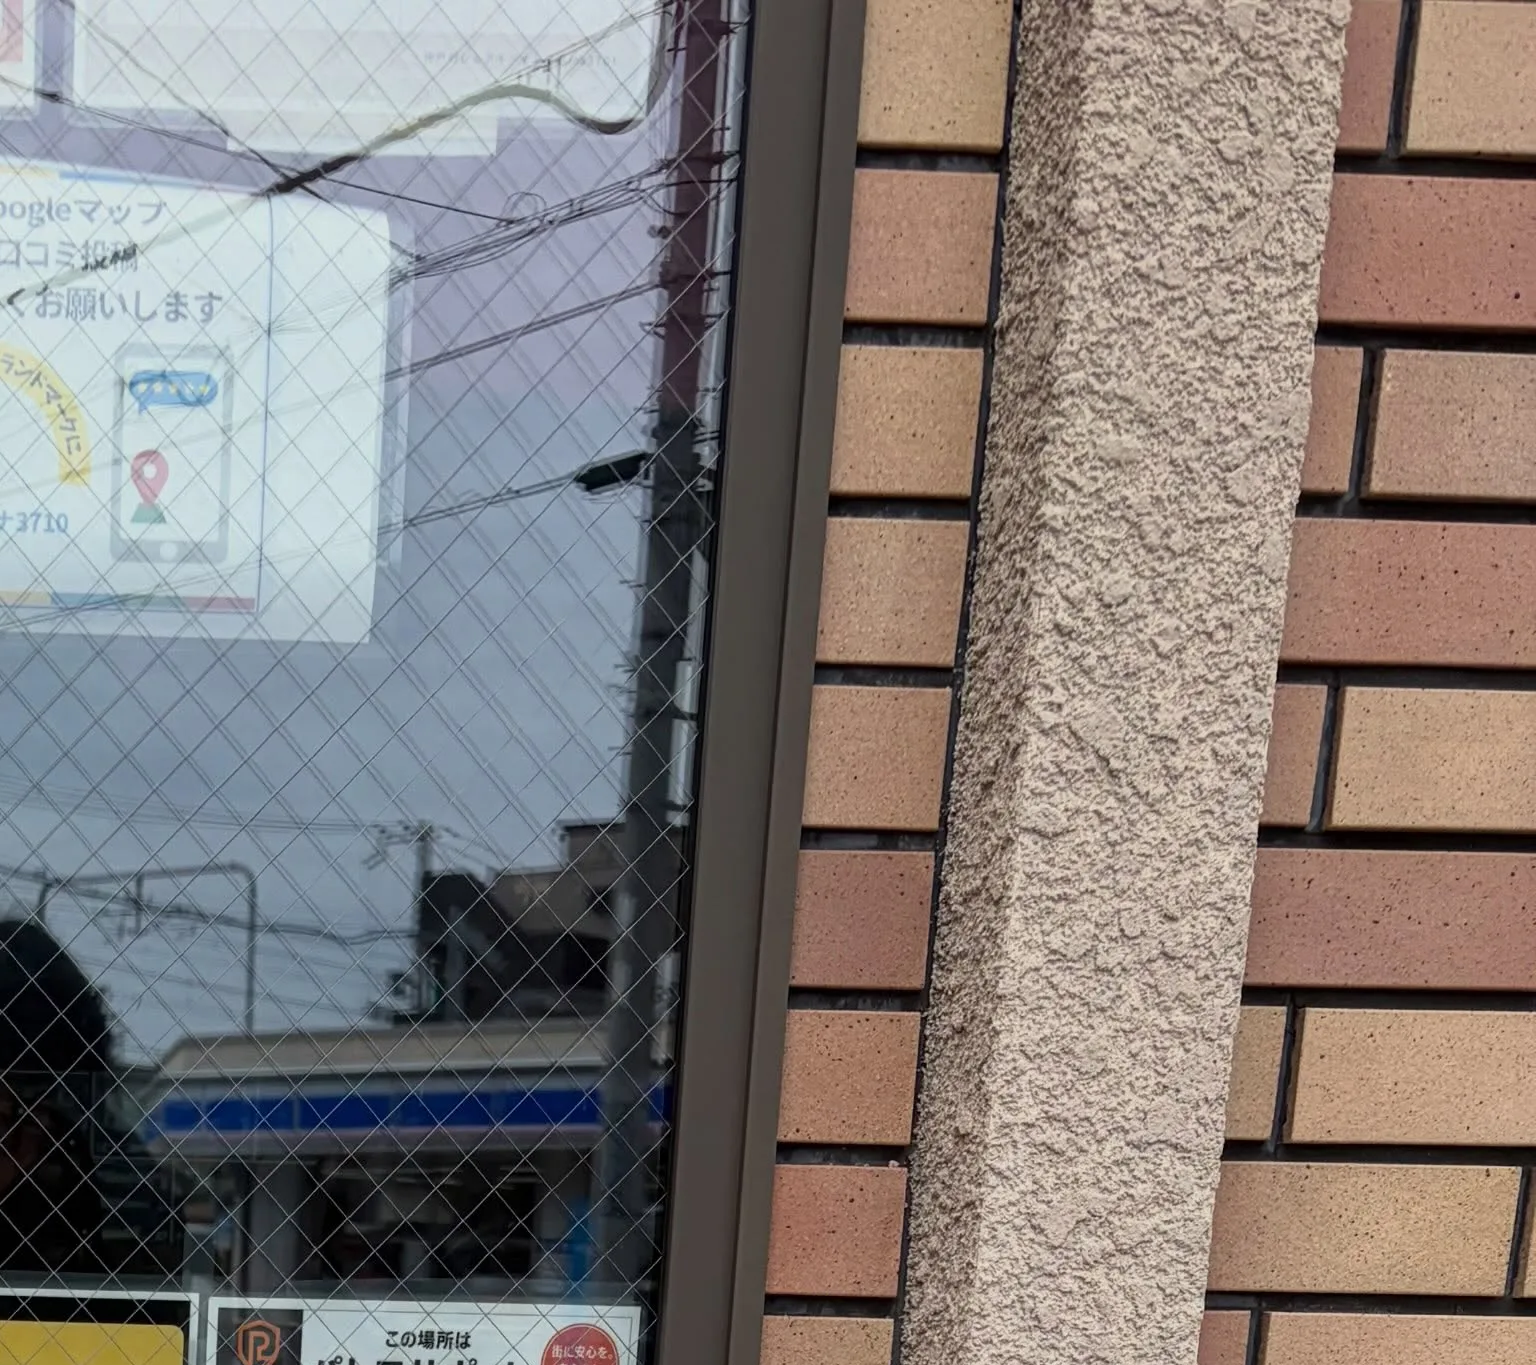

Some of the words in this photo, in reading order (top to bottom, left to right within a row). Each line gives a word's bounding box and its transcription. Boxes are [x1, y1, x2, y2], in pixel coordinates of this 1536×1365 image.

[385, 1330, 471, 1350] この場所は
[551, 1344, 614, 1361] 街に安心を。
